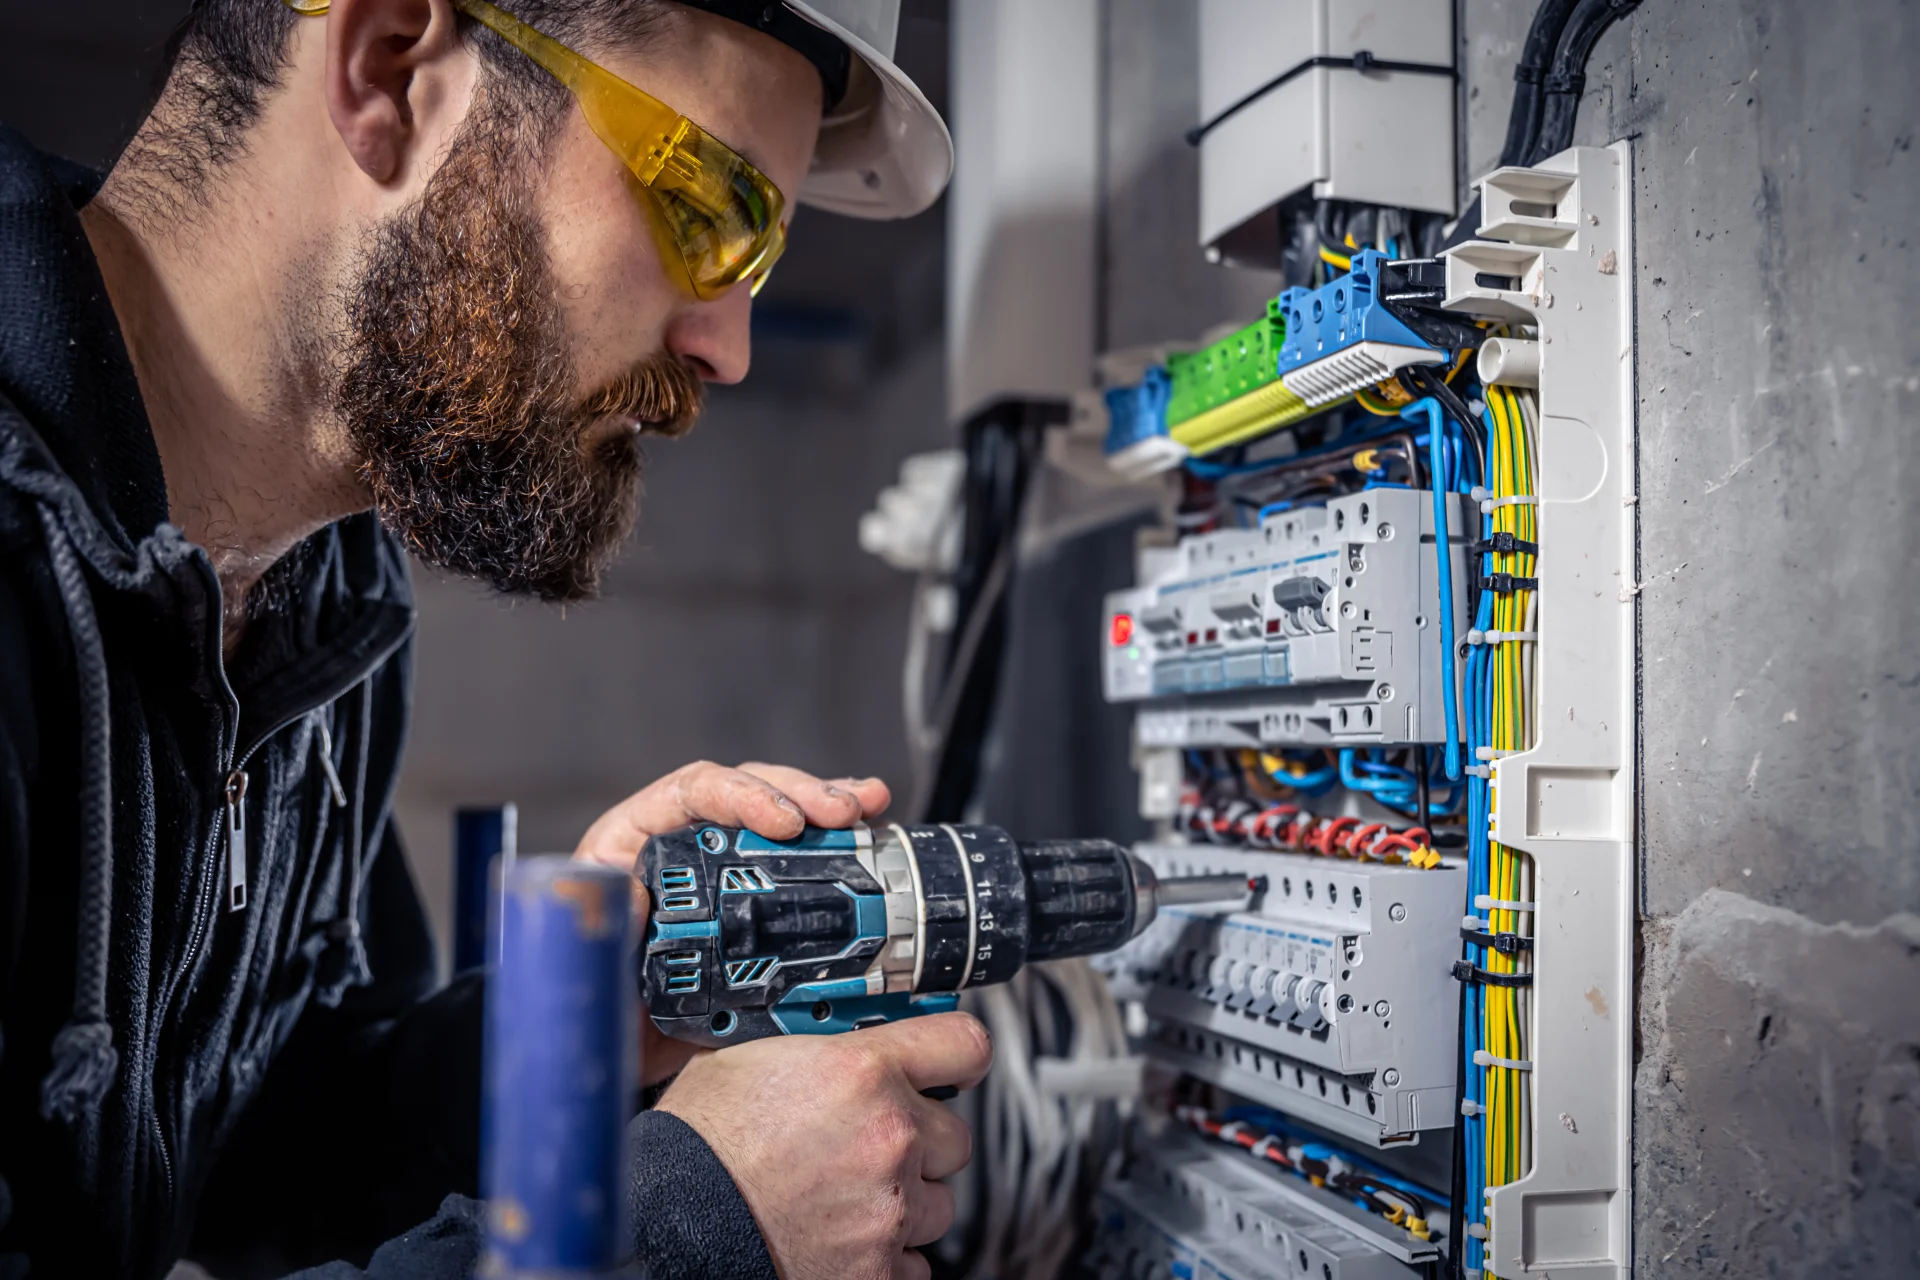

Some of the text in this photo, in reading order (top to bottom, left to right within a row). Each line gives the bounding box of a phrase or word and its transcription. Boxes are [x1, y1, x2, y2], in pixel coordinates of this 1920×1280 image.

[962, 832, 977, 840] 7
[971, 853, 985, 863] 9
[976, 880, 992, 898] 11
[979, 911, 994, 931] 13
[977, 944, 992, 960] 15
[972, 970, 987, 981] 17
